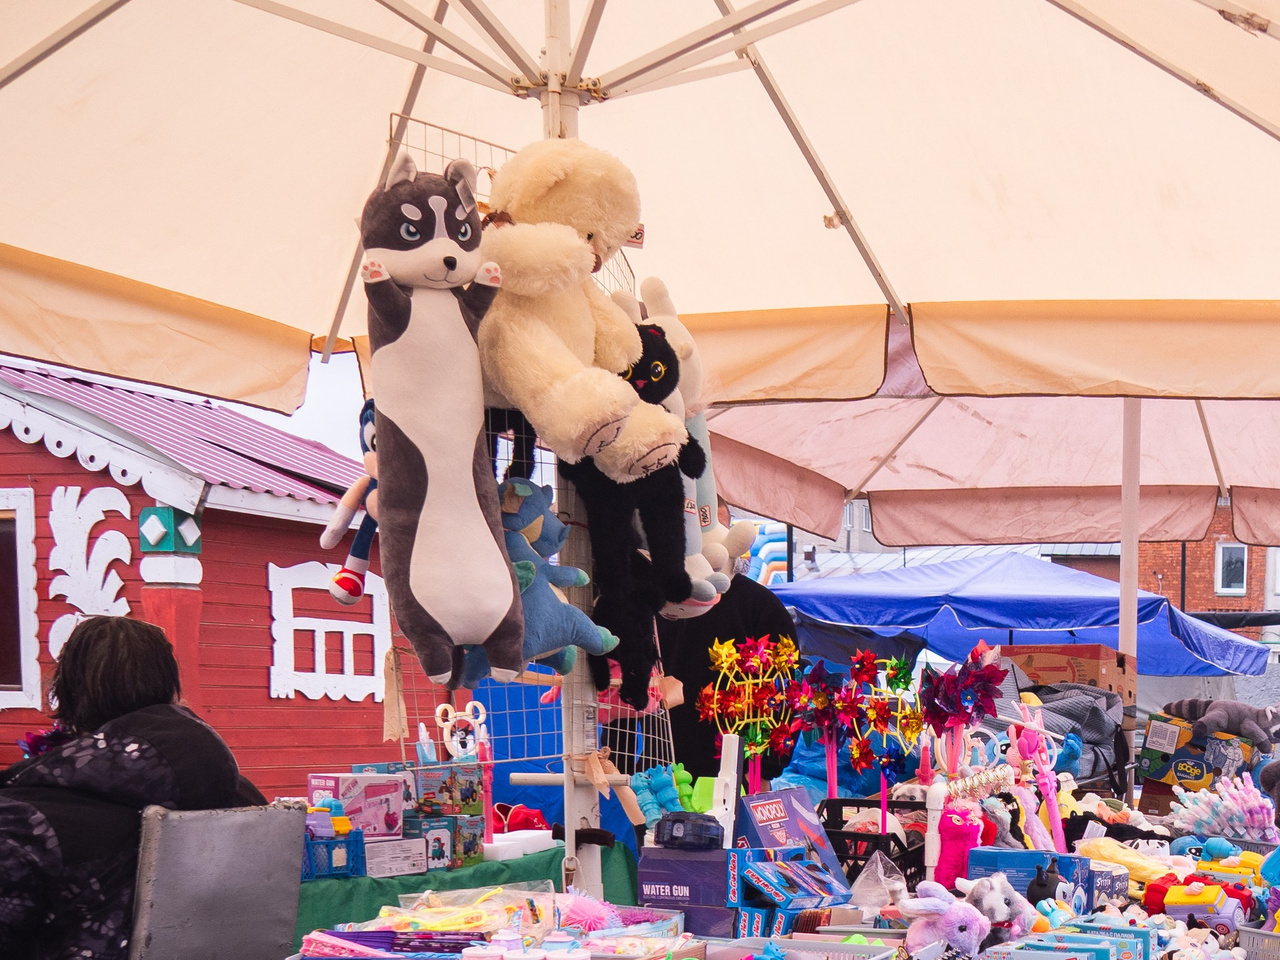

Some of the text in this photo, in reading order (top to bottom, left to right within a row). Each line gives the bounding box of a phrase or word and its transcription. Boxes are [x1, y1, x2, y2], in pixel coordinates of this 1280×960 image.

[754, 803, 786, 821] MONOPOLY
[642, 884, 689, 897] WATER GUN
